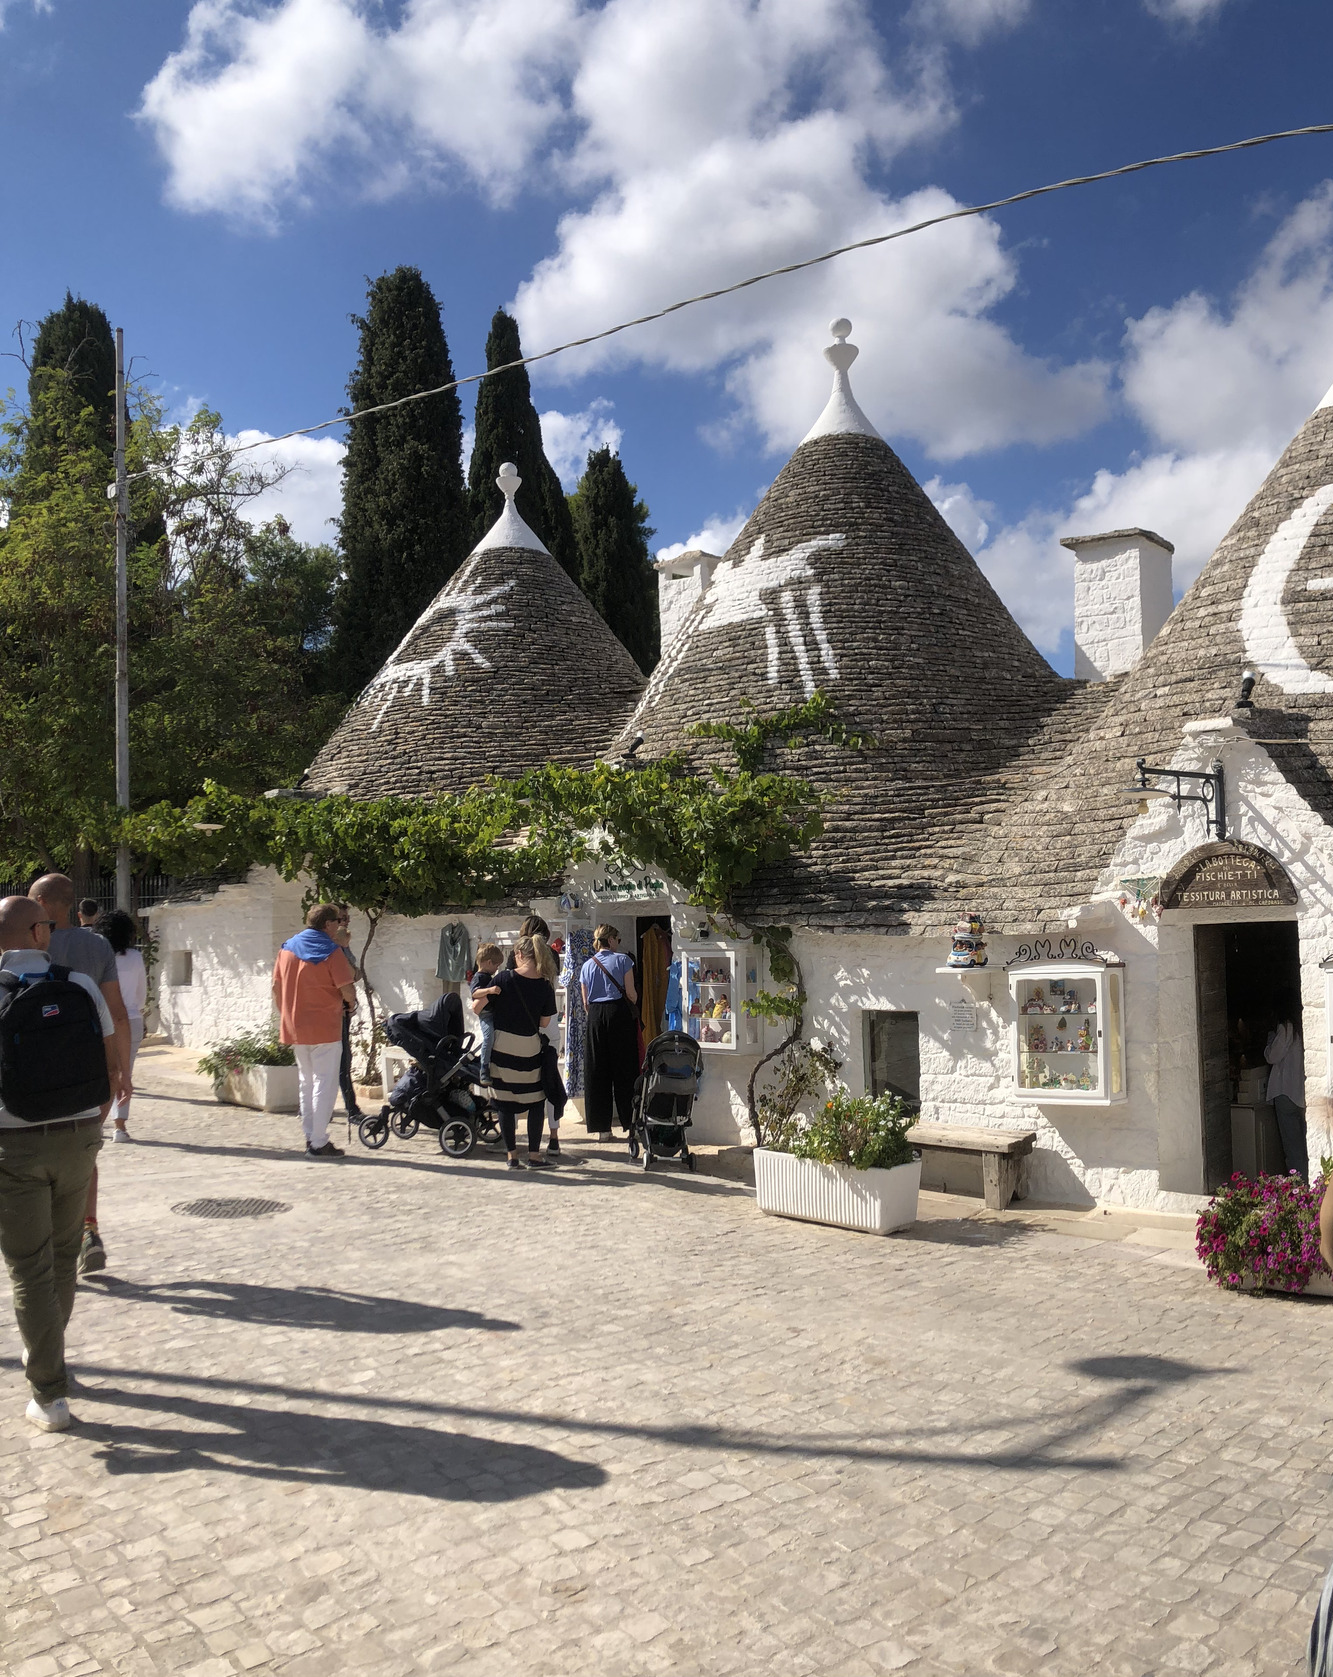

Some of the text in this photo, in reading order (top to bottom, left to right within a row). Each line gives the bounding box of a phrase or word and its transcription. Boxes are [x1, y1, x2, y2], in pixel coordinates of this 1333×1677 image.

[1195, 870, 1258, 882] FISCHIETTI
[1176, 889, 1280, 902] TESSITURA ARTISTICA
